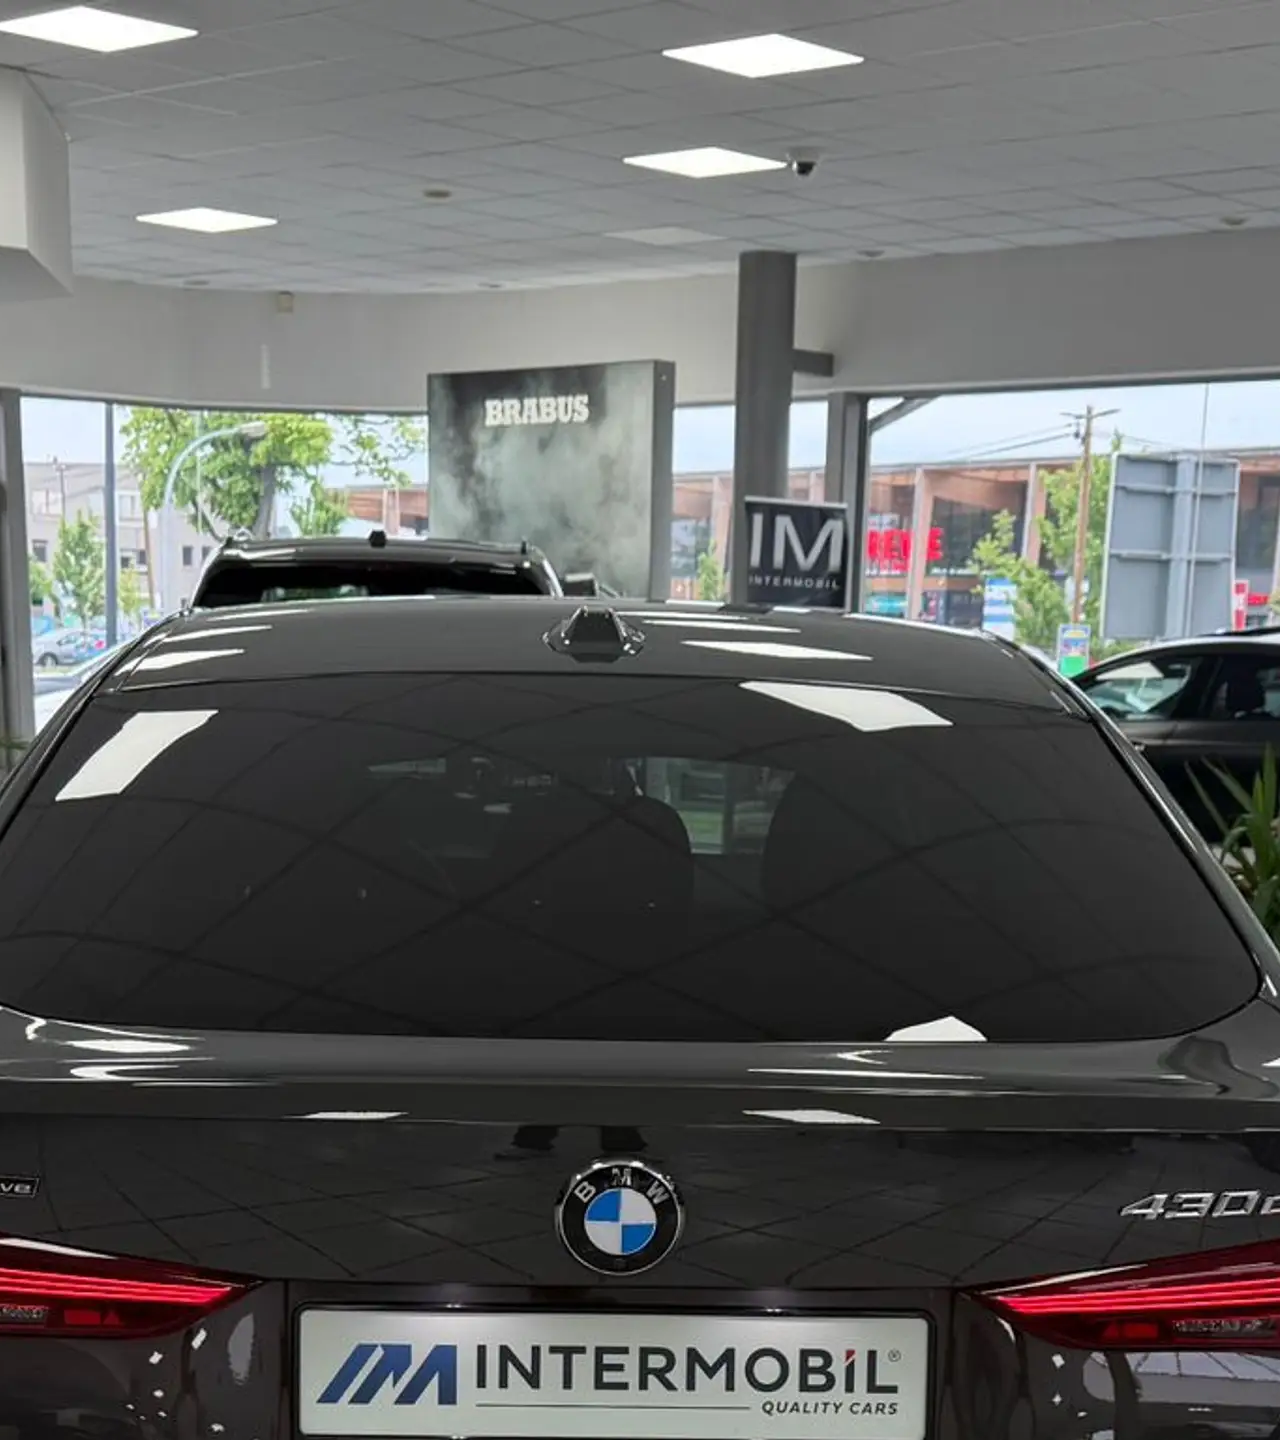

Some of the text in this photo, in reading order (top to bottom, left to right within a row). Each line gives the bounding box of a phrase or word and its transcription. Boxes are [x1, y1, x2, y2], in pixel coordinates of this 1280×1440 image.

[485, 395, 589, 427] BRABUS
[750, 512, 844, 573] IM
[748, 574, 840, 590] INTERMOBIL
[573, 1167, 670, 1205] BMW
[761, 1400, 898, 1416] QUALITY CARS
